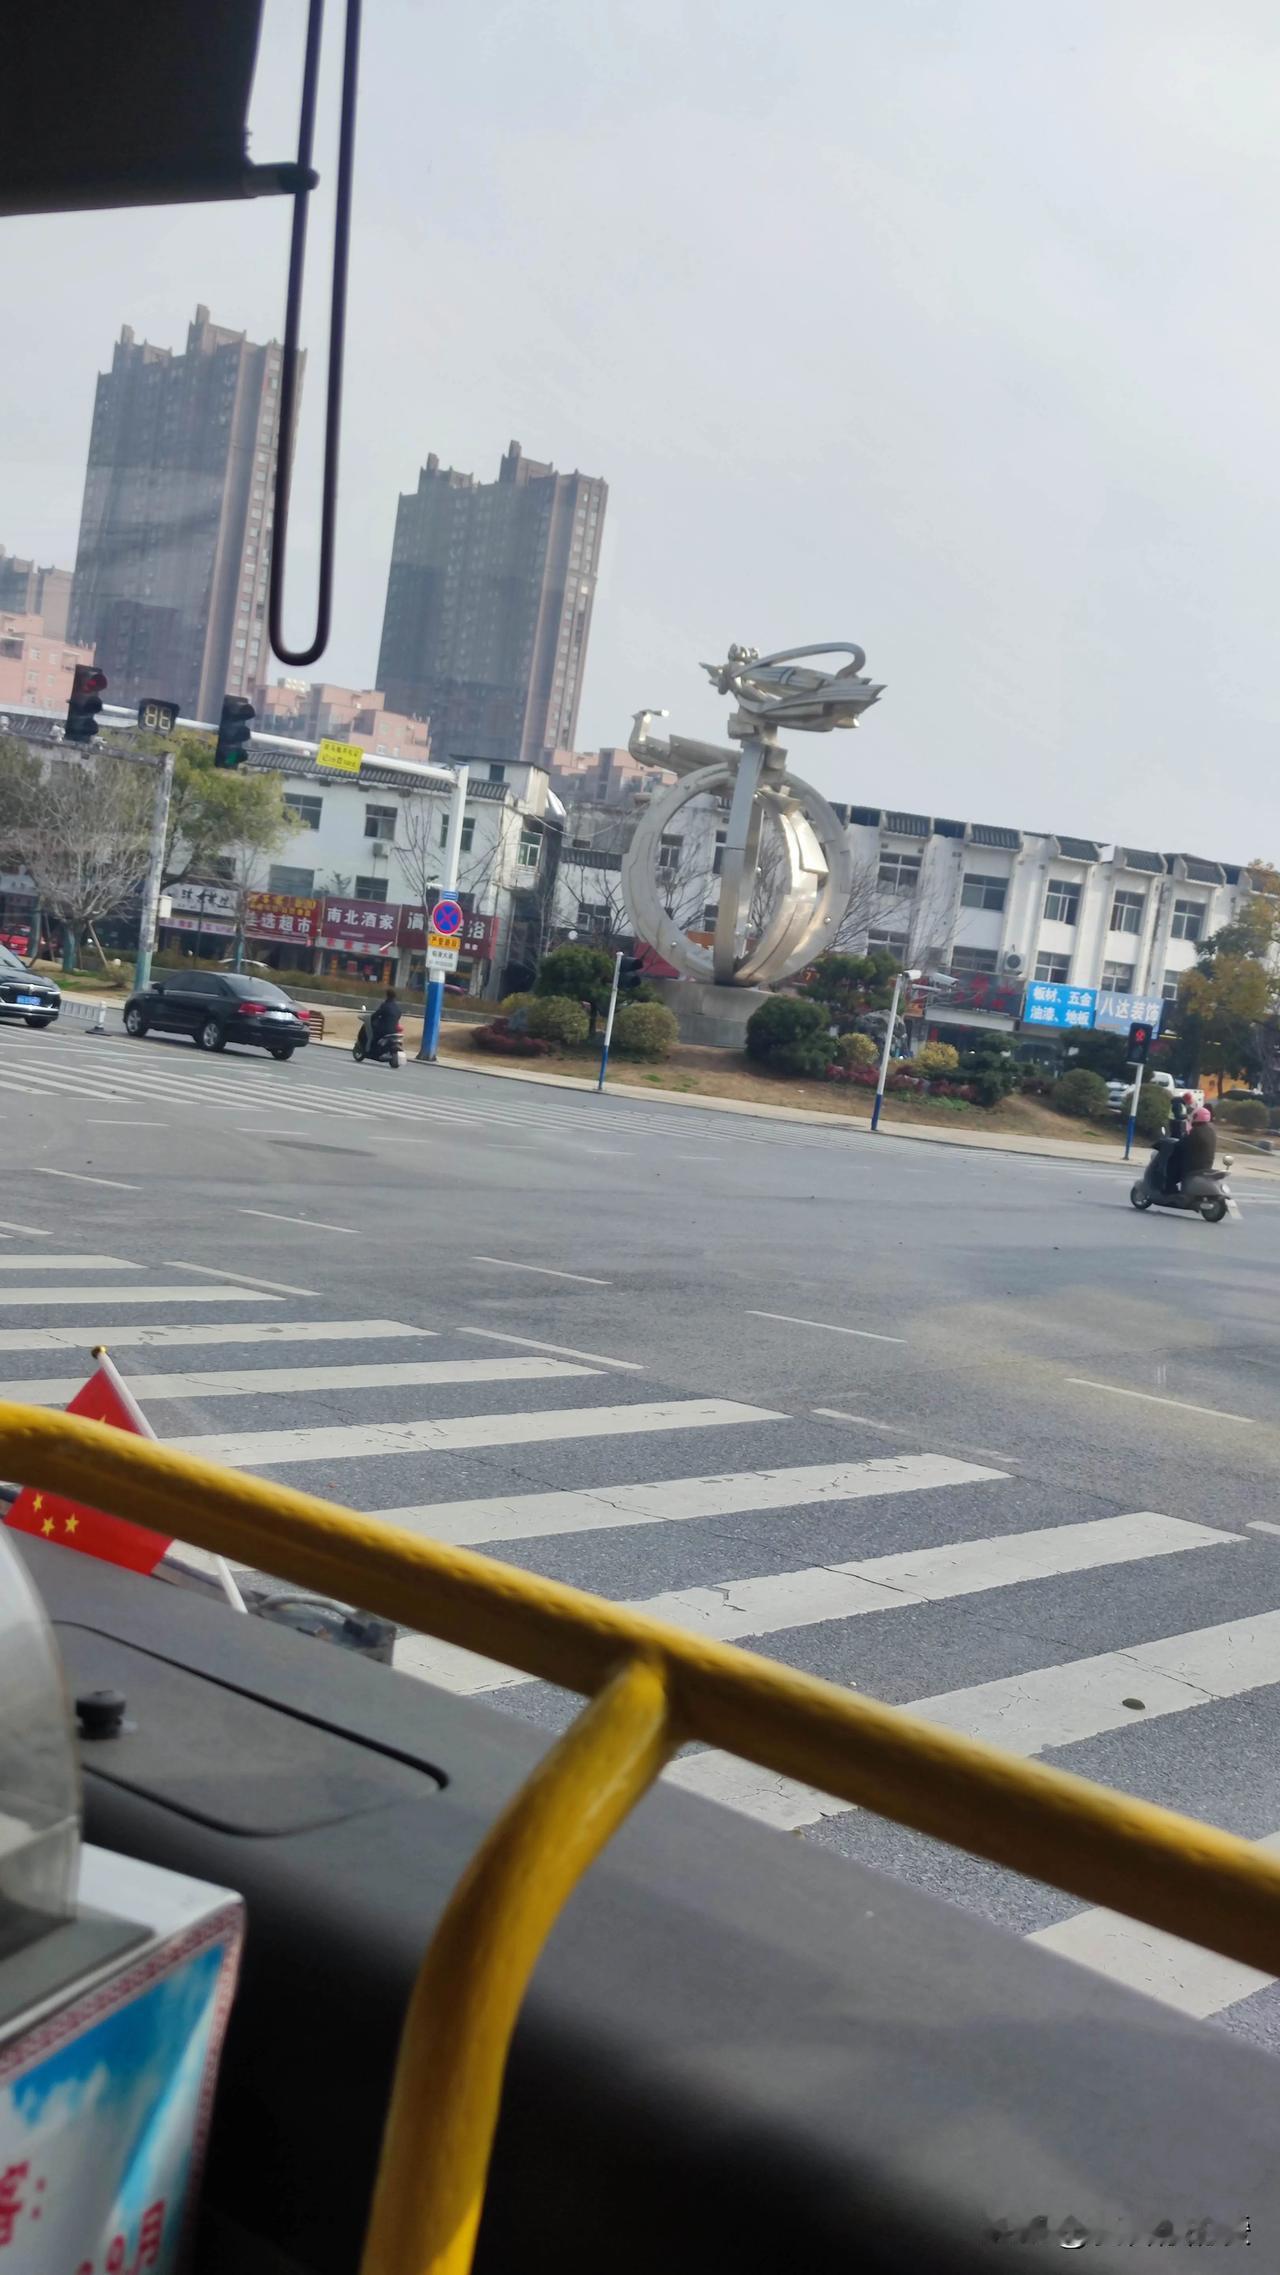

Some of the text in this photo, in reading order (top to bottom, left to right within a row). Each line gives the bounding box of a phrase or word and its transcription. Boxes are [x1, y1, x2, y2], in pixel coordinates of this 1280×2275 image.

[327, 906, 394, 930] 南北酒家
[406, 911, 486, 940] 满浴
[1033, 985, 1092, 1007] 板材、五金
[1030, 1004, 1090, 1026] 油漆、地板
[1100, 997, 1160, 1024] 八达装饰
